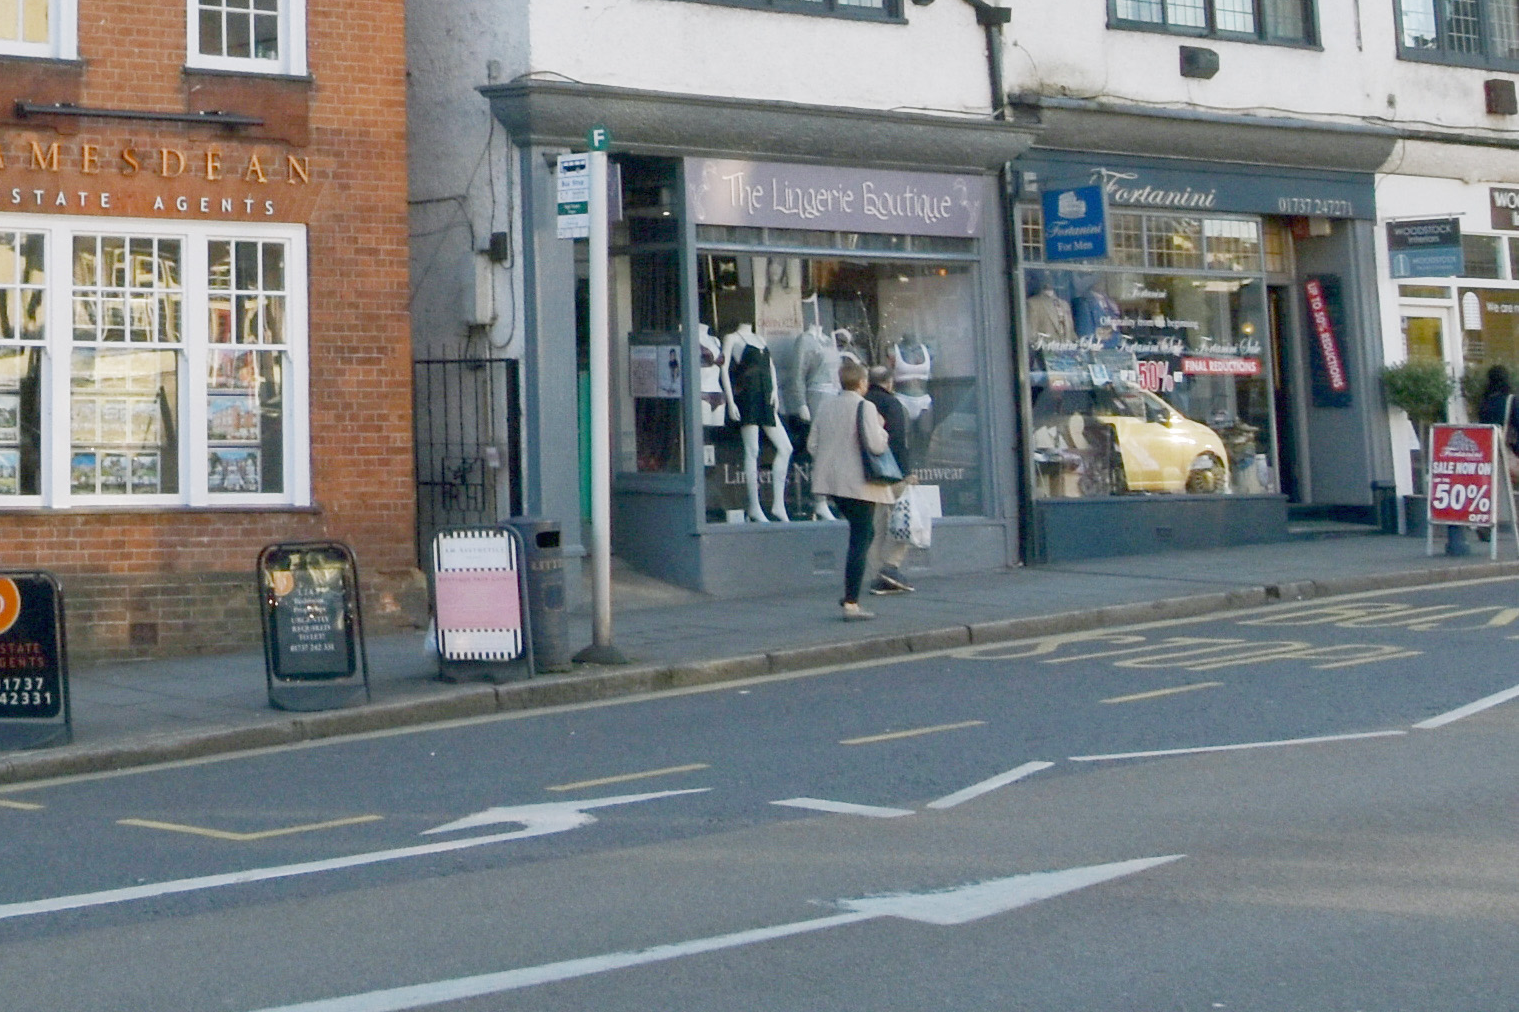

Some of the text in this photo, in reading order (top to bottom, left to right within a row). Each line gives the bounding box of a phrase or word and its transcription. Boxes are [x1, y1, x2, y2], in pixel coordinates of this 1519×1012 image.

[593, 129, 605, 147] F
[153, 195, 275, 215] AGENTS
[722, 171, 952, 224] The Lingerie Boutique
[1277, 196, 1353, 216] 01737 247271
[1047, 220, 1103, 238] Fortanini
[1394, 224, 1452, 235] WOODSTOCK
[1057, 241, 1093, 251] For Men
[1485, 301, 1499, 313] We
[1185, 360, 1258, 372] FINAL REDUCTIONS
[1137, 360, 1175, 392] 50%
[1432, 461, 1492, 476] SALE NOW ON
[1432, 483, 1491, 512] 50%
[1468, 513, 1490, 522] OFF
